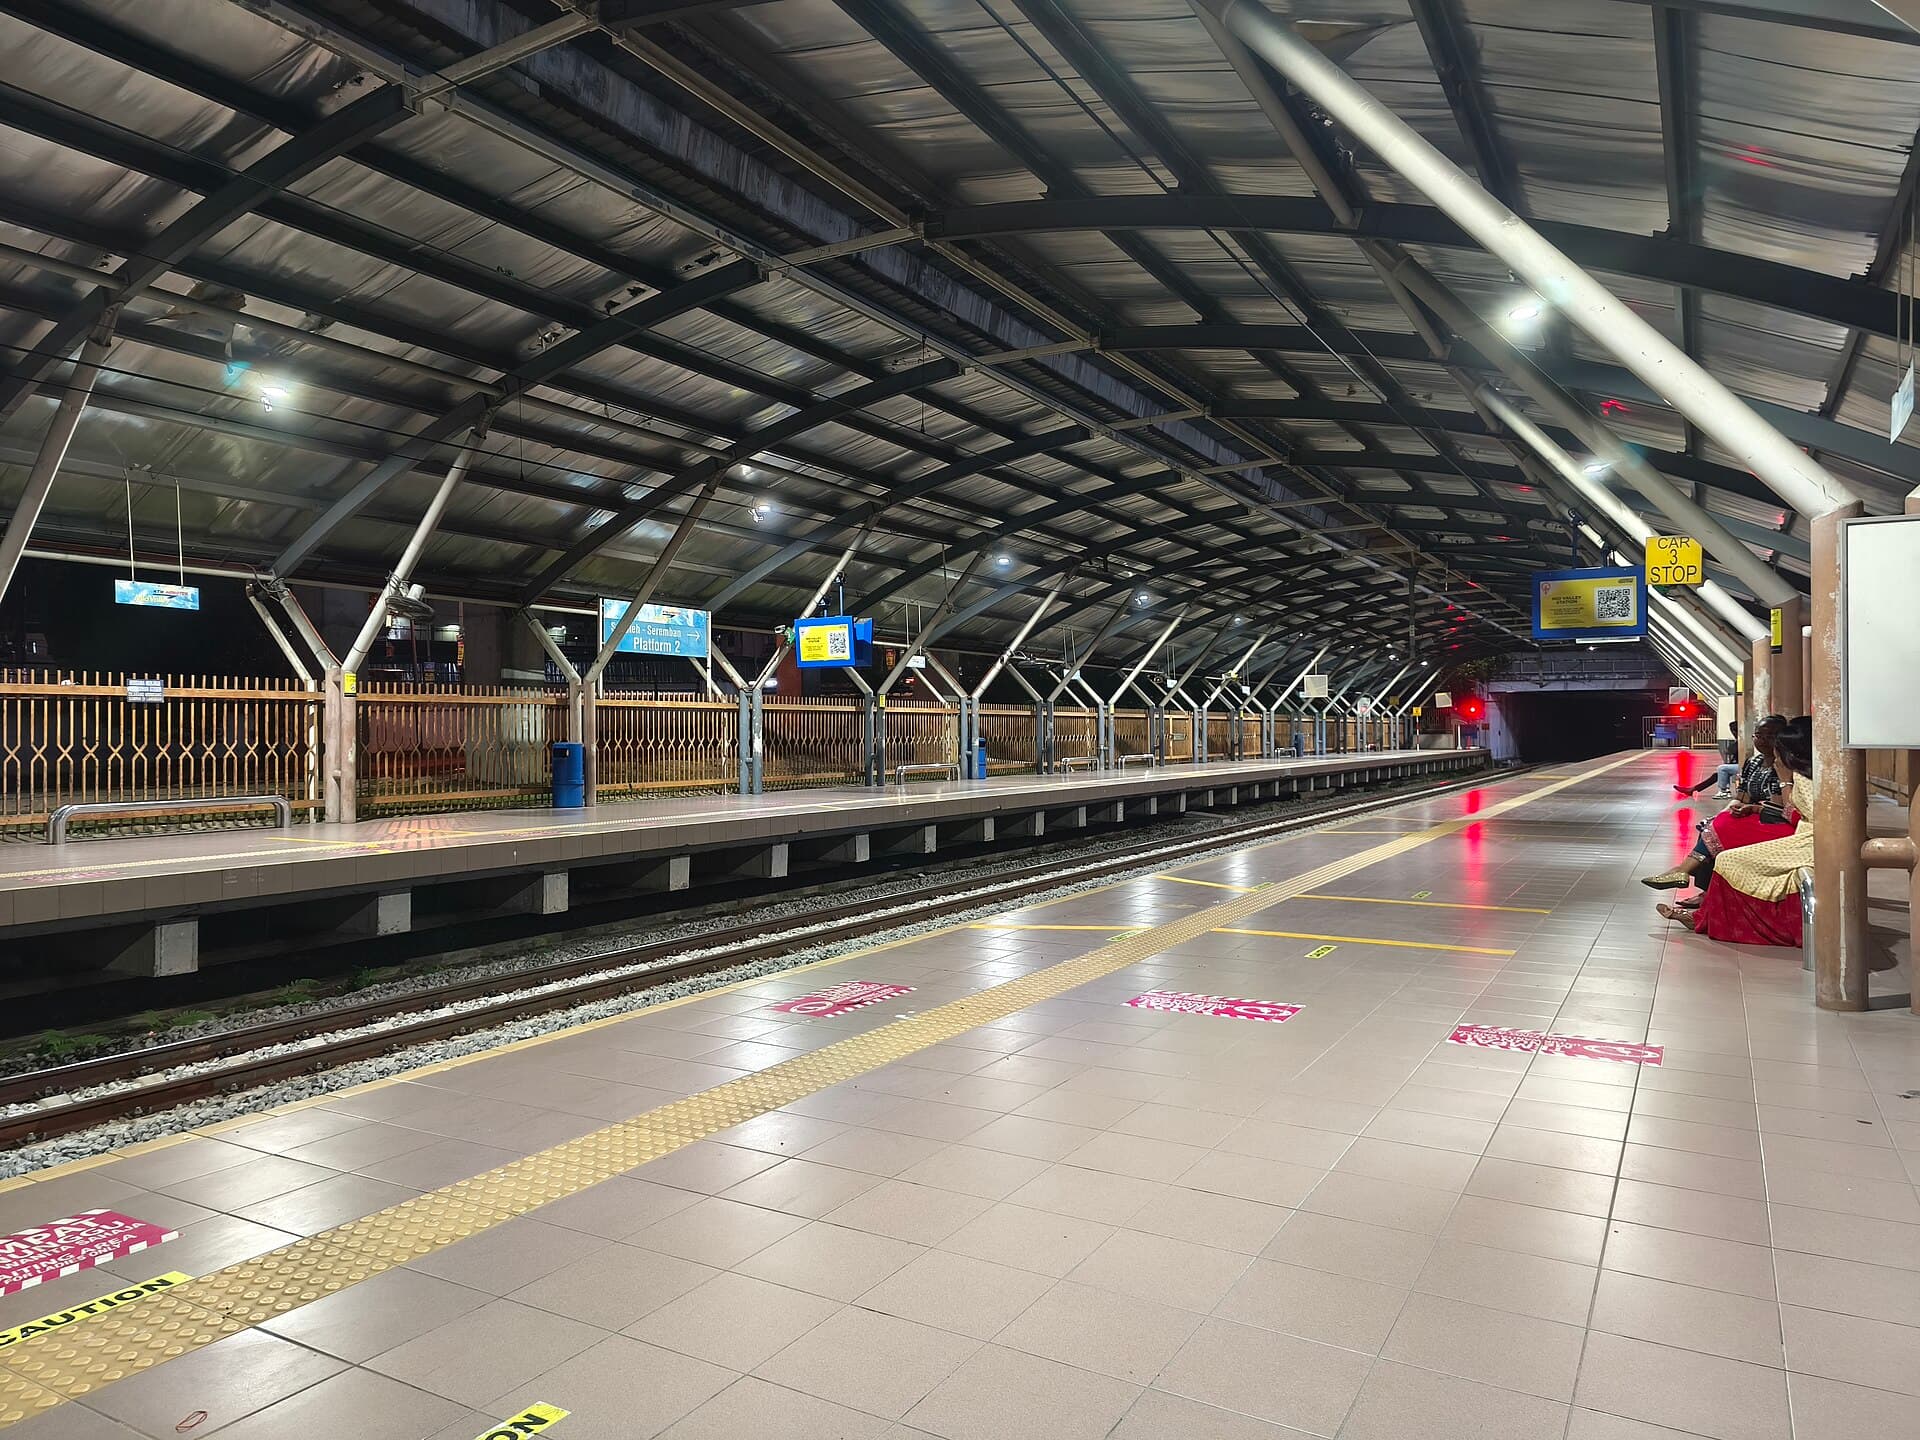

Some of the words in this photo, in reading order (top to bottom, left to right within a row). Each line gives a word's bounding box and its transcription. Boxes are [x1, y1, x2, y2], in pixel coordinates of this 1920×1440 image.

[1657, 537, 1690, 549] CAR
[1669, 548, 1678, 565] 3
[1650, 565, 1697, 583] STOP
[646, 625, 682, 637] Seremban
[633, 637, 672, 653] Platform
[674, 640, 681, 653] 2
[1, 1244, 75, 1270] WANITA
[75, 1222, 147, 1246] SAHAJA
[80, 1234, 137, 1256] AREA
[4, 1272, 33, 1285] FOR
[38, 1253, 86, 1274] LADIES
[88, 1244, 121, 1257] ONLY
